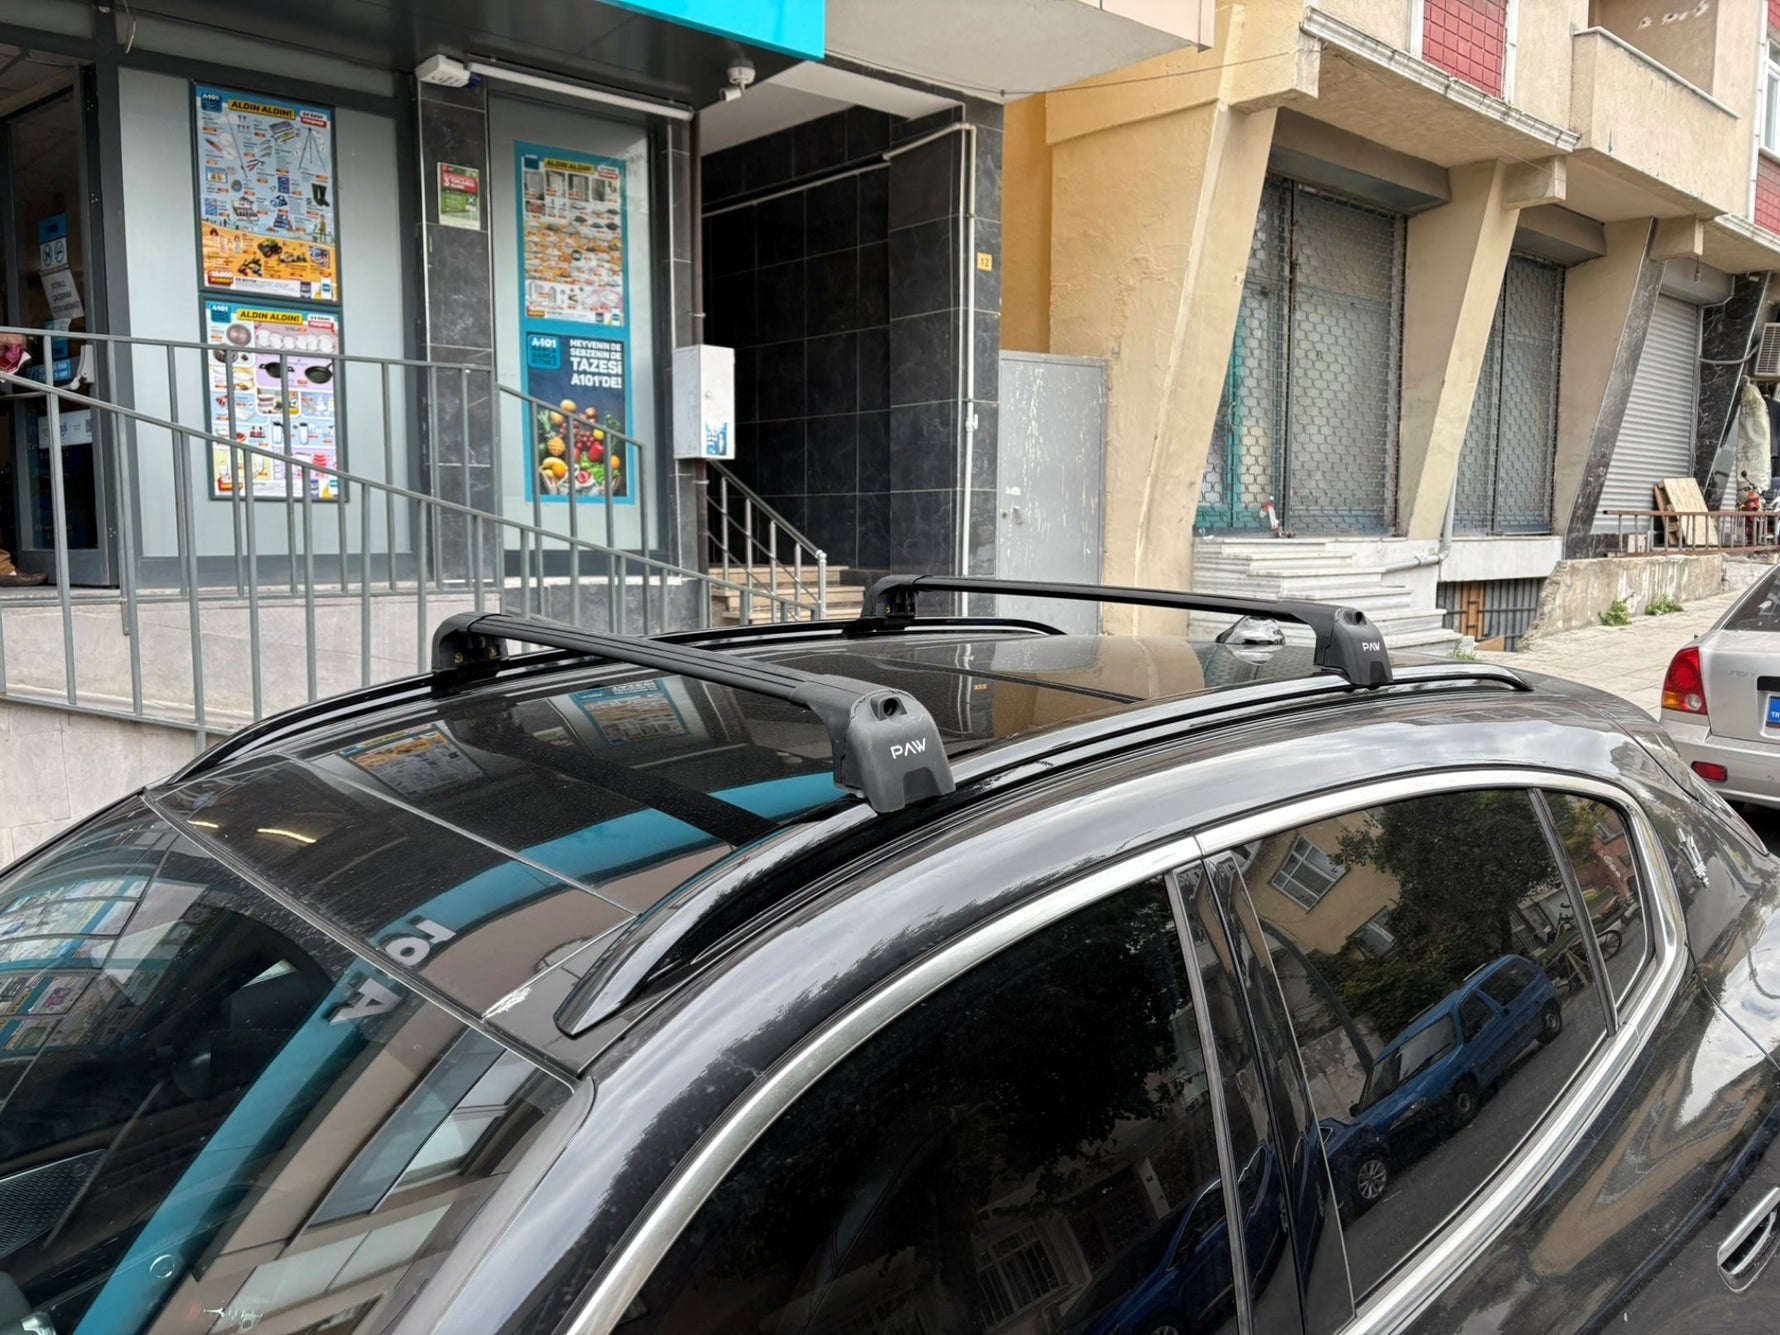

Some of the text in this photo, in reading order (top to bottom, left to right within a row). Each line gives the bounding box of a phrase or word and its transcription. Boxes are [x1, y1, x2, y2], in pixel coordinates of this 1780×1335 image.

[231, 101, 260, 112] ALDIN
[261, 104, 292, 118] ALDIN!
[980, 257, 989, 267] 12
[240, 310, 267, 319] ALDIN
[270, 313, 300, 322] ALDIN!
[610, 343, 622, 351] DE
[610, 352, 622, 360] DE
[1362, 642, 1380, 652] PAW
[890, 737, 926, 759] PAW
